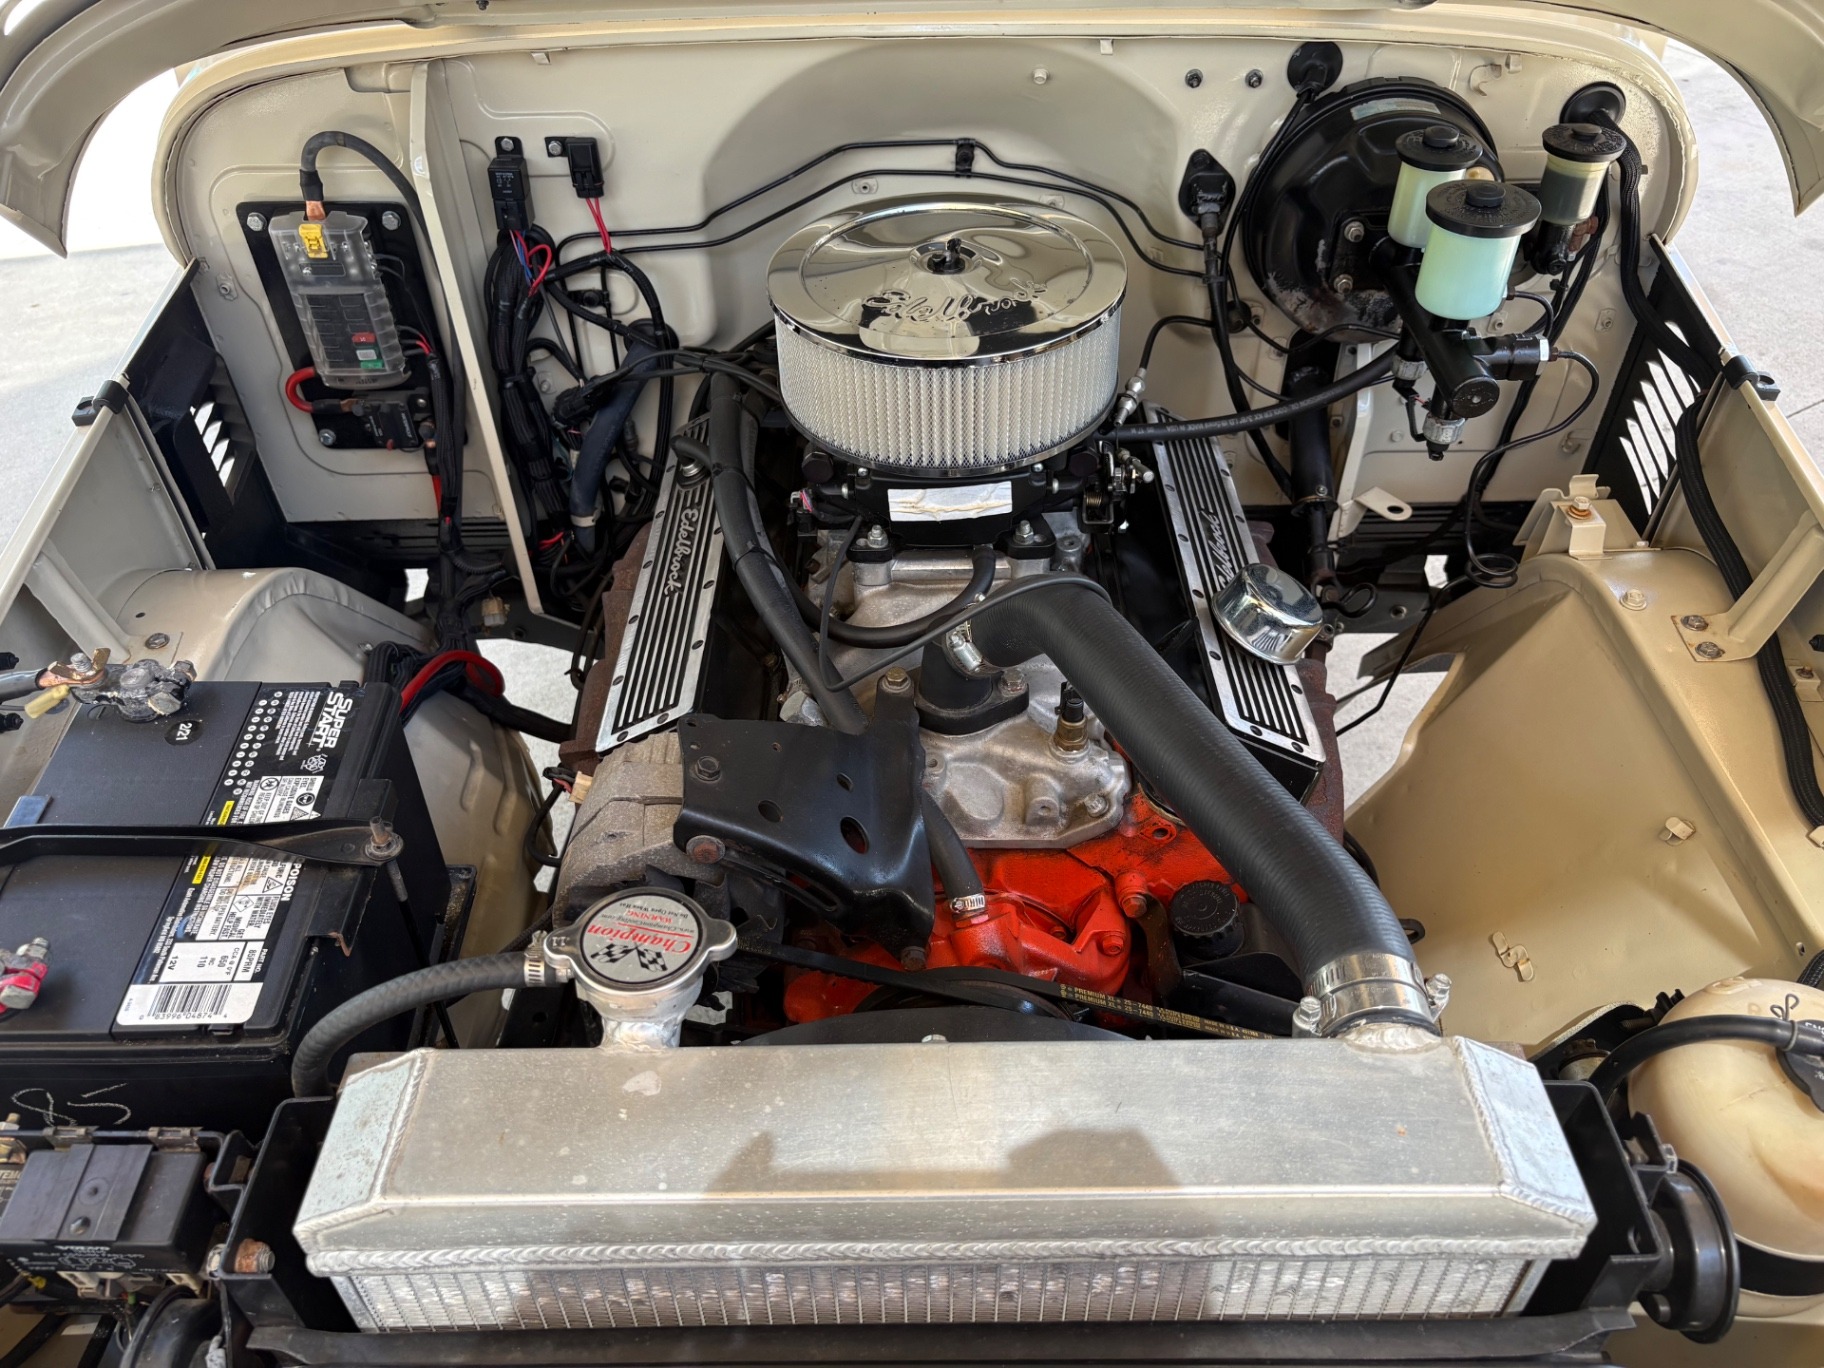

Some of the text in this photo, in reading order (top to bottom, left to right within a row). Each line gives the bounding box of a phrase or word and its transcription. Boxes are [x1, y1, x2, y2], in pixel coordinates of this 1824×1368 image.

[862, 278, 1048, 322] Edelbrock
[1187, 422, 1208, 431] MADE
[664, 506, 699, 598] Edelbrock
[315, 691, 342, 748] START
[324, 697, 353, 748] SUPER
[176, 721, 193, 743] 2/21
[280, 863, 301, 900] POISON
[226, 911, 236, 923] HELP
[626, 910, 673, 923] WARNING
[651, 907, 666, 916] Open
[235, 928, 244, 938] GET
[588, 924, 691, 954] Champion
[230, 947, 239, 959] CCA
[166, 955, 179, 970] 12V
[196, 956, 208, 967] 110
[216, 955, 229, 967] 650
[240, 949, 257, 972] 85PRM
[253, 948, 268, 973] PART NO.
[1074, 987, 1106, 1000] PREMIUM
[1074, 994, 1106, 1006] PREMIUM
